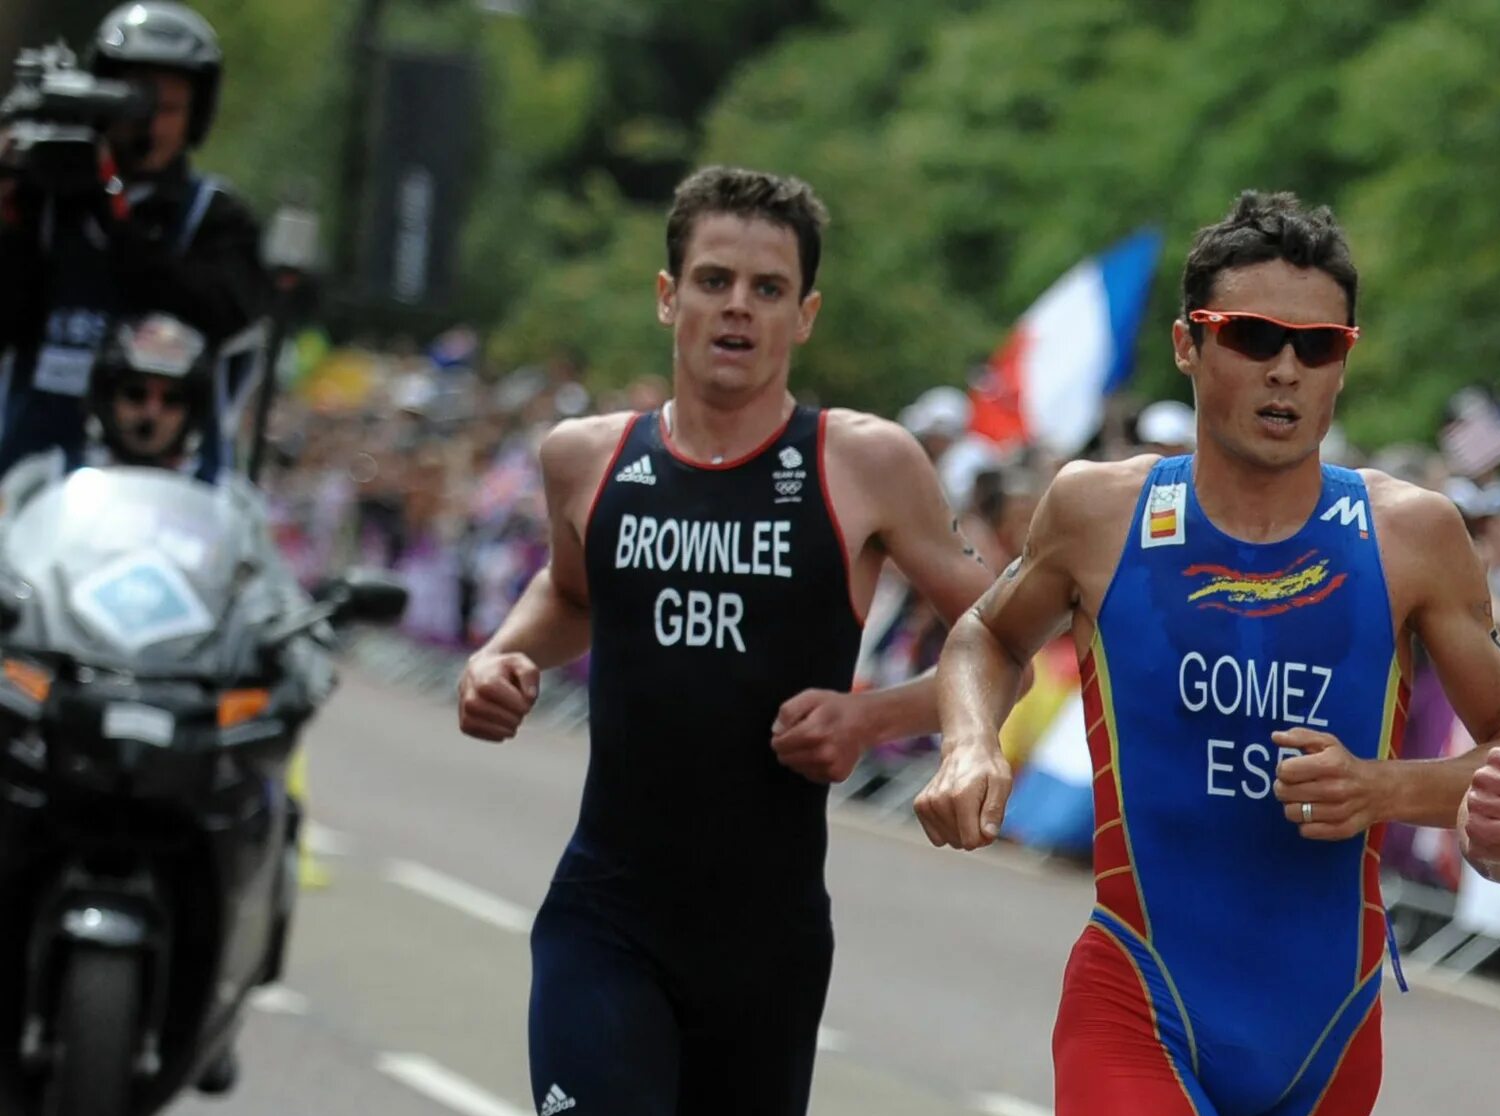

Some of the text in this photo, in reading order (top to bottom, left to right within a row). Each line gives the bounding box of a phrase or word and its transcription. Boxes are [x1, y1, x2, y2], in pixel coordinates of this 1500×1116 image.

[616, 472, 656, 486] adidas
[615, 513, 792, 578] BROWNLEE
[654, 587, 747, 653] GBR
[1179, 651, 1332, 727] GOMEZ
[1207, 739, 1304, 799] ES
